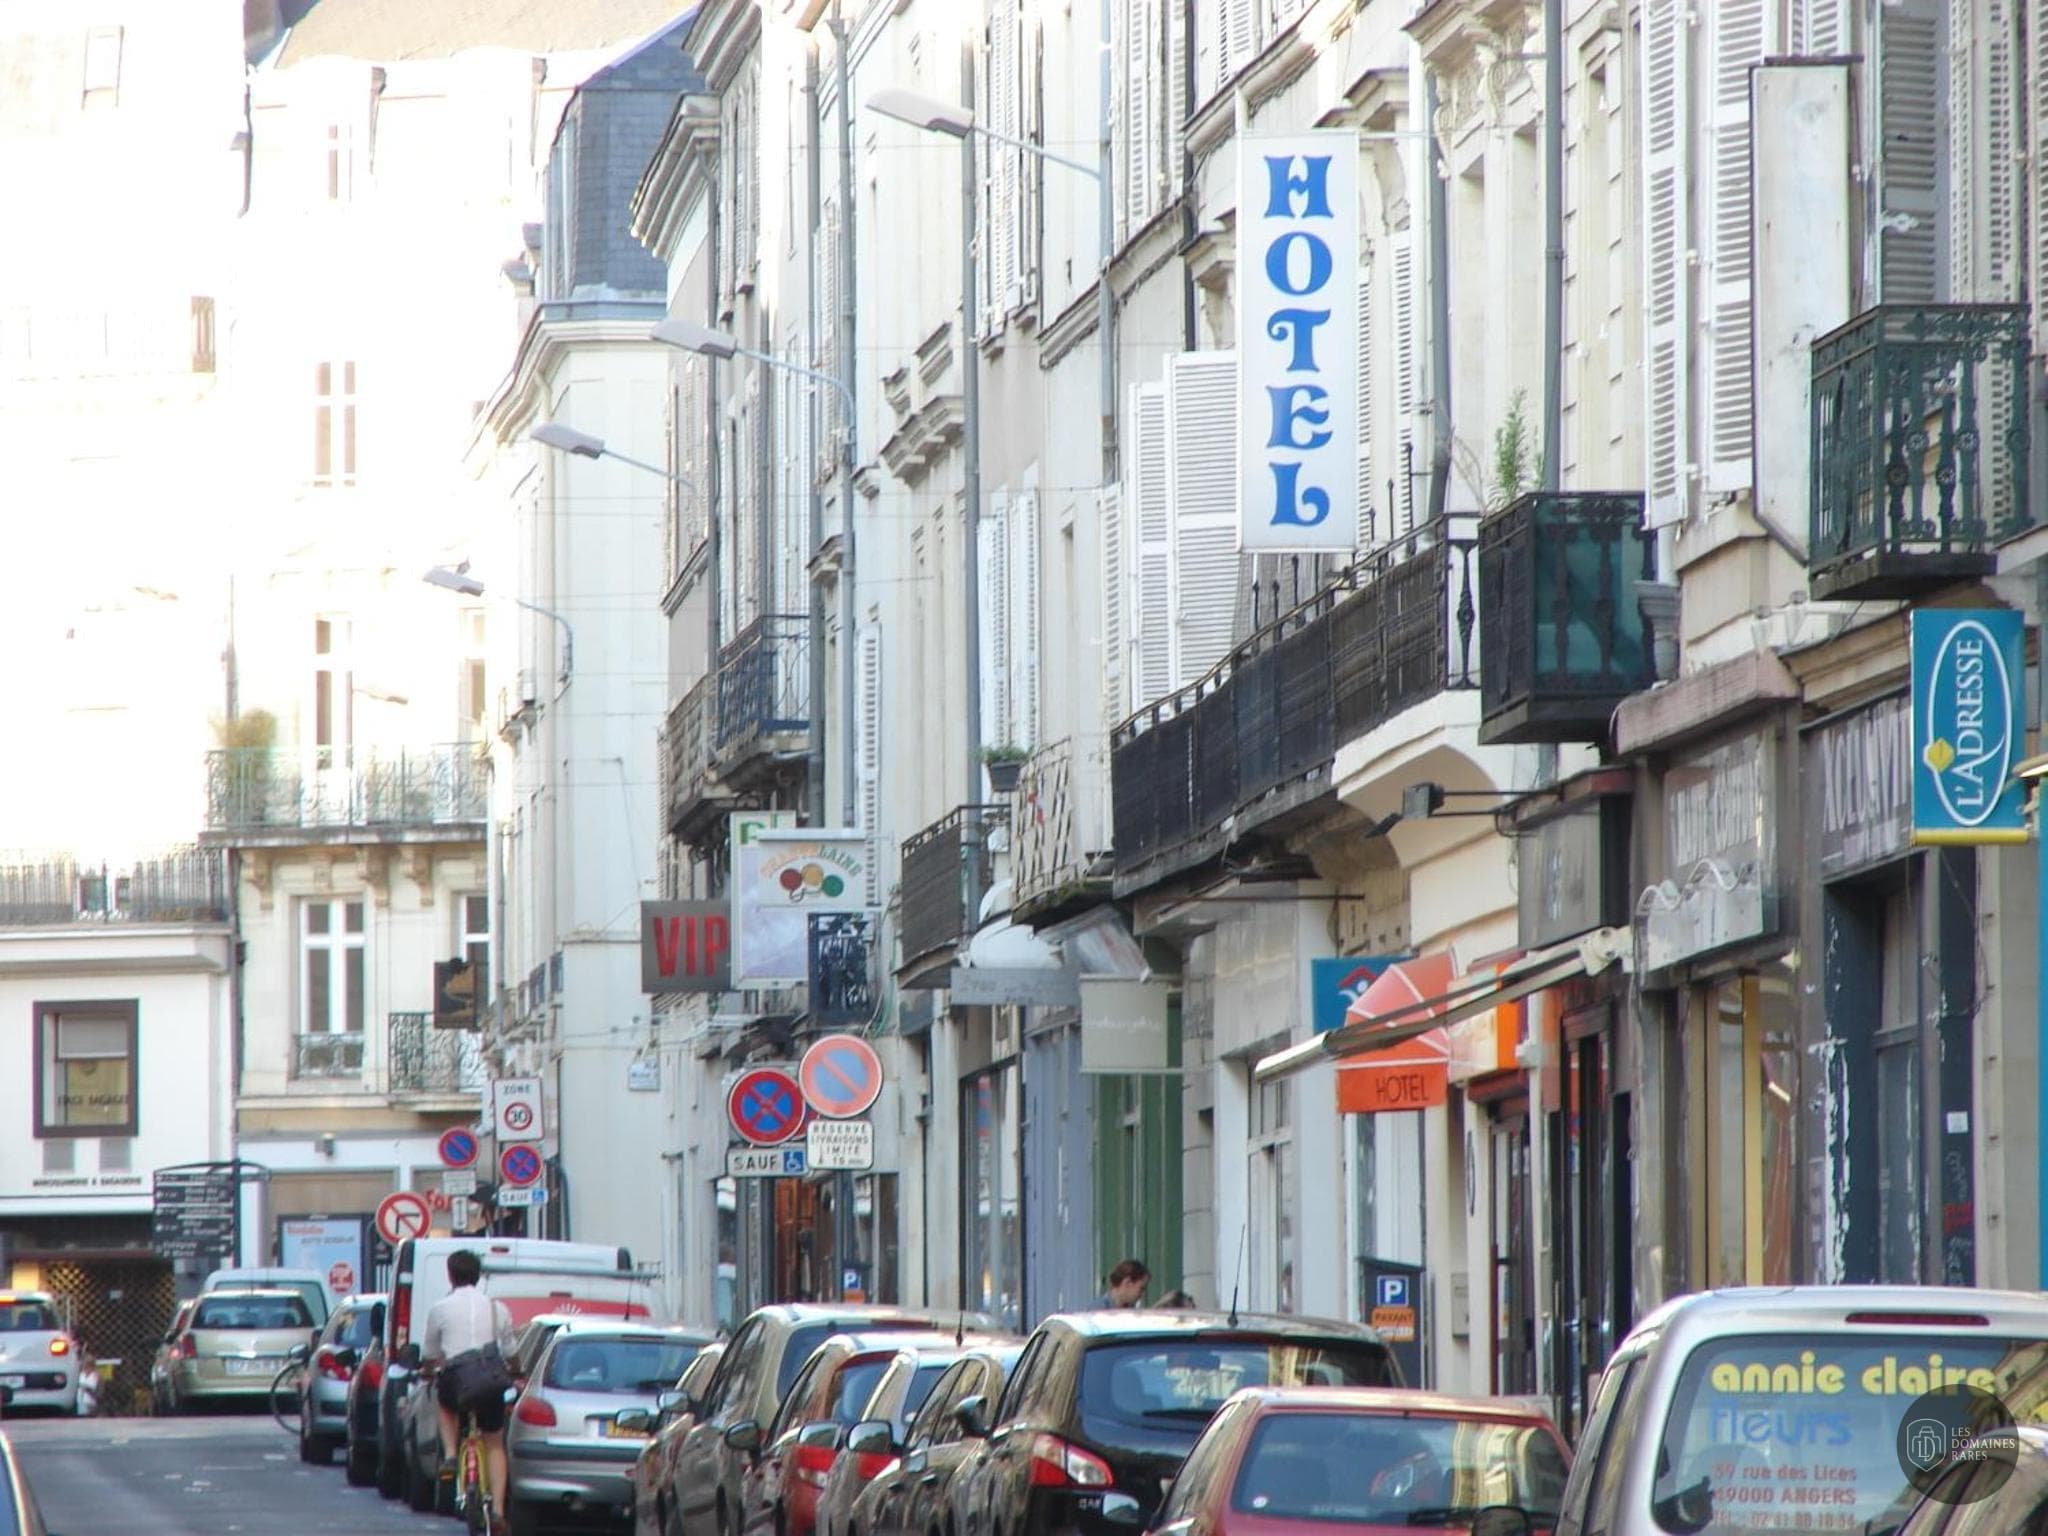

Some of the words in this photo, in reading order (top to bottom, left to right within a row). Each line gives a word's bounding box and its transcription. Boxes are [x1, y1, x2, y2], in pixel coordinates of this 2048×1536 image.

[1263, 155, 1334, 527] HOTEL
[1952, 638, 1985, 808] L'ADRESSE
[654, 915, 729, 978] VIP
[503, 1084, 531, 1096] ZONE
[1375, 1073, 1430, 1103] HOTEL
[511, 1109, 529, 1123] 30
[733, 1156, 778, 1169] SAUF
[1385, 1279, 1403, 1303] P
[1711, 1350, 1846, 1394] annie
[1861, 1353, 1998, 1396] claire
[1742, 1465, 1771, 1480] rue
[1777, 1463, 1807, 1480] des
[1813, 1463, 1858, 1482] Lices
[1780, 1486, 1857, 1505] ANGERS
